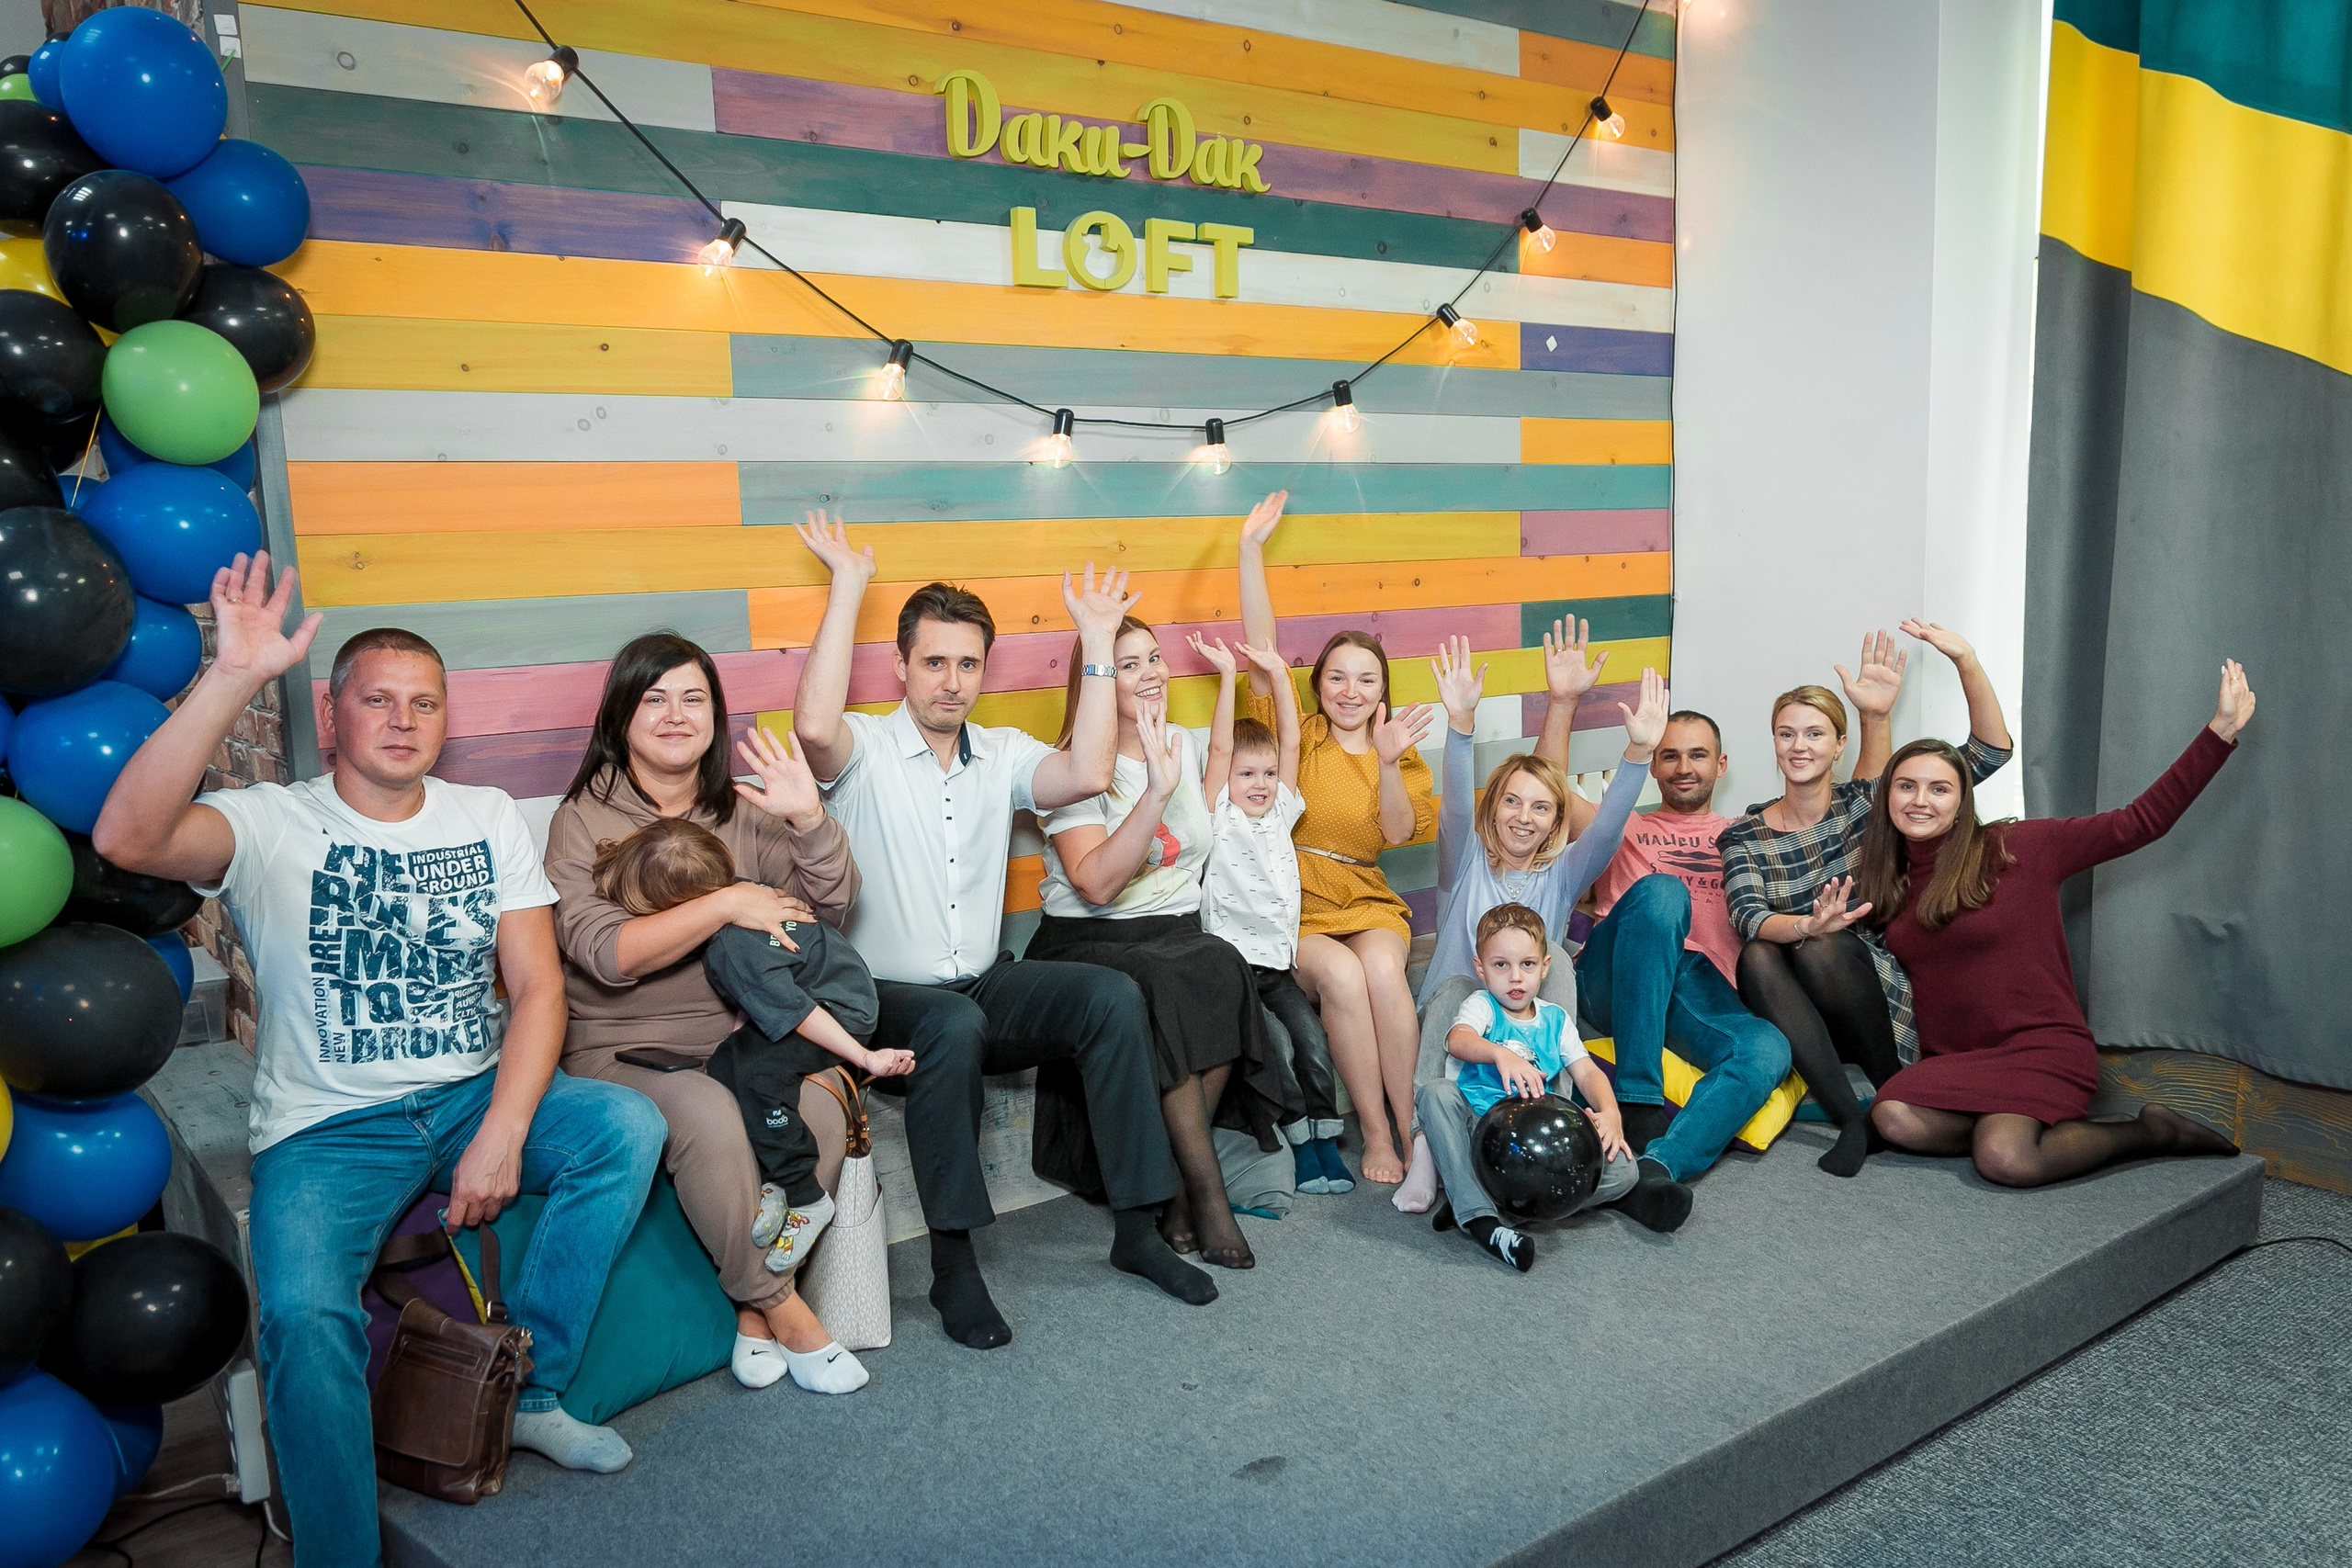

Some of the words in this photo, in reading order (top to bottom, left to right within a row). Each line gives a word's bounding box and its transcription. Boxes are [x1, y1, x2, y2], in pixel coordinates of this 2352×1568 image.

[1010, 207, 1254, 299] LOFT
[413, 845, 484, 864] INDUSTRIAL
[414, 854, 487, 881] UNDER
[418, 870, 490, 894] GROUND
[312, 976, 328, 1063] INNOVATION
[333, 1032, 345, 1063] NEW
